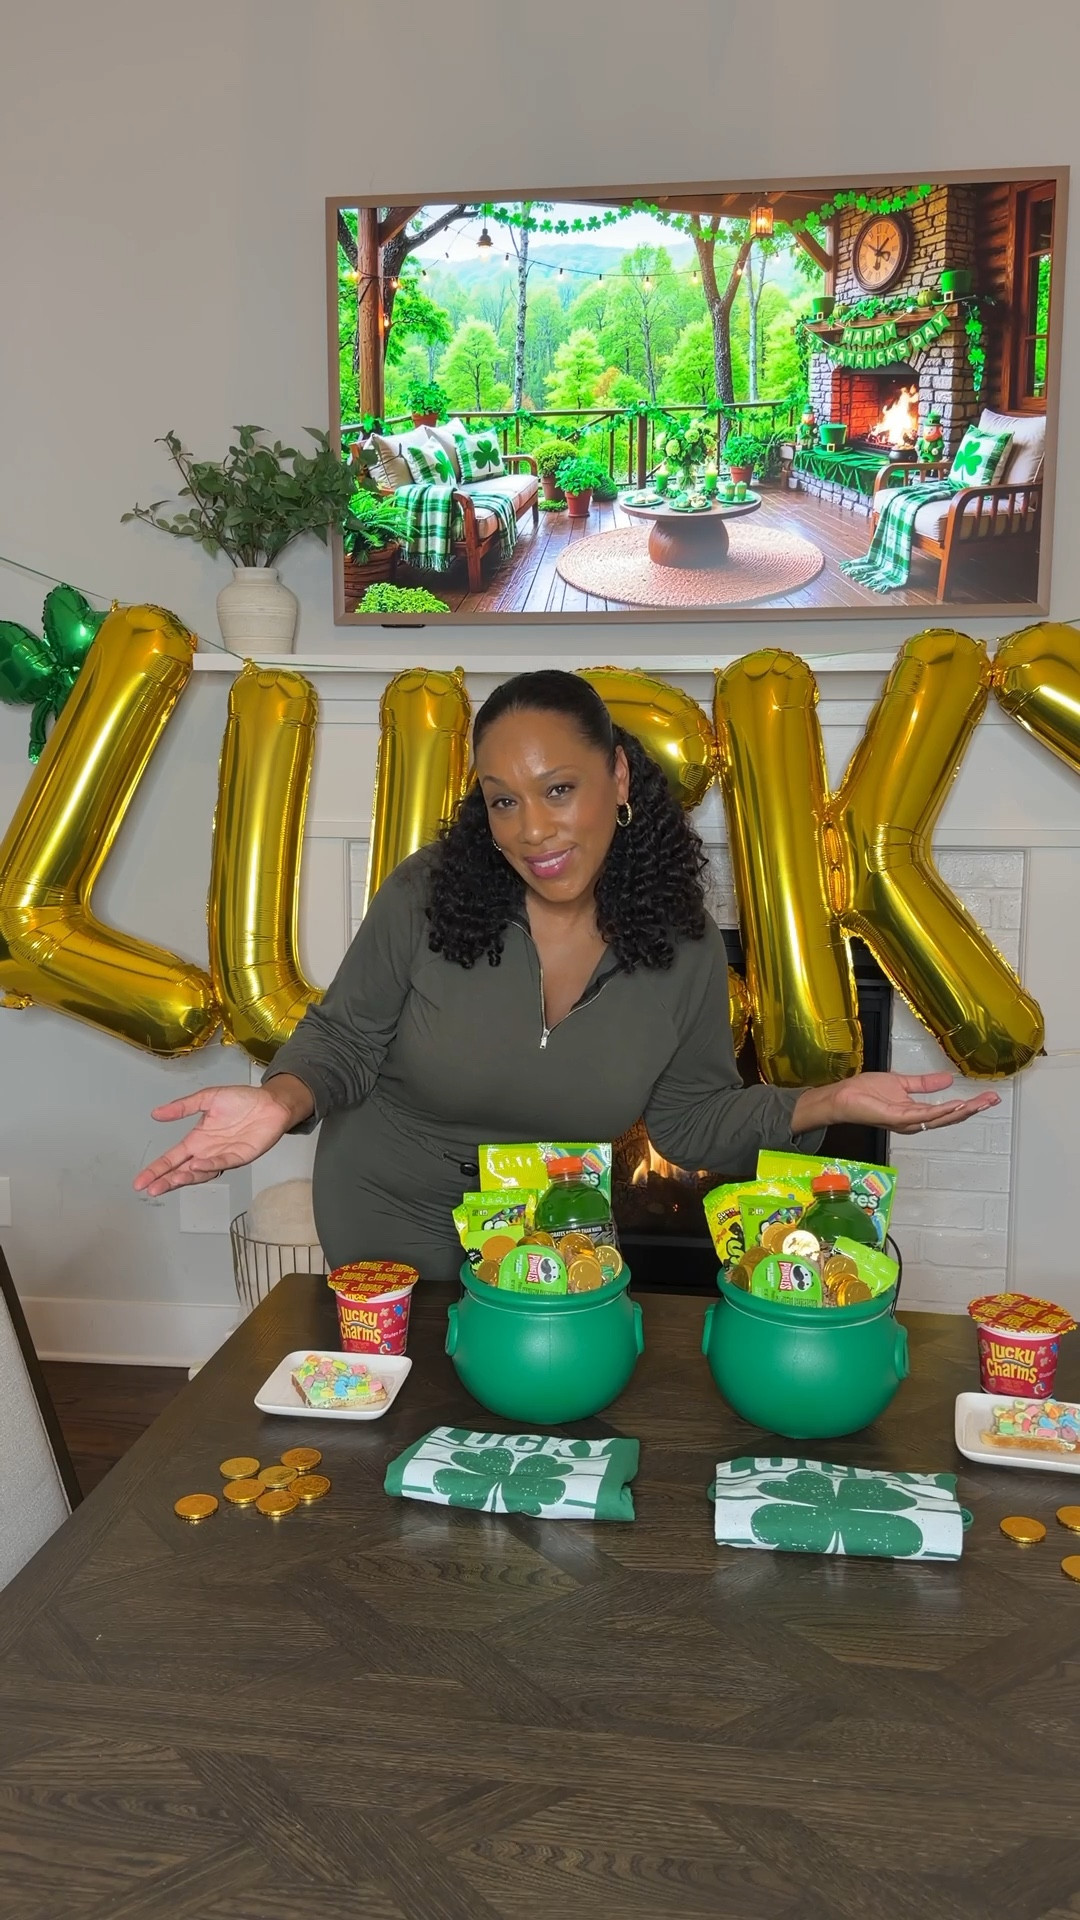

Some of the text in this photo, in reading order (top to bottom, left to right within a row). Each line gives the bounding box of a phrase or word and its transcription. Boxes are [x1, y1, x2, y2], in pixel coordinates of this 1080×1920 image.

[829, 343, 907, 363] PATRICK'S
[911, 315, 944, 346] DAY
[845, 323, 894, 341] HAPPY
[0, 602, 1080, 1083] LUK
[849, 1191, 878, 1208] tes
[527, 1254, 541, 1284] PRINGLES
[779, 1262, 793, 1290] PRINGLES
[341, 1321, 382, 1345] Charms
[986, 1358, 1038, 1383] Charms
[431, 1426, 618, 1457] LUCKY
